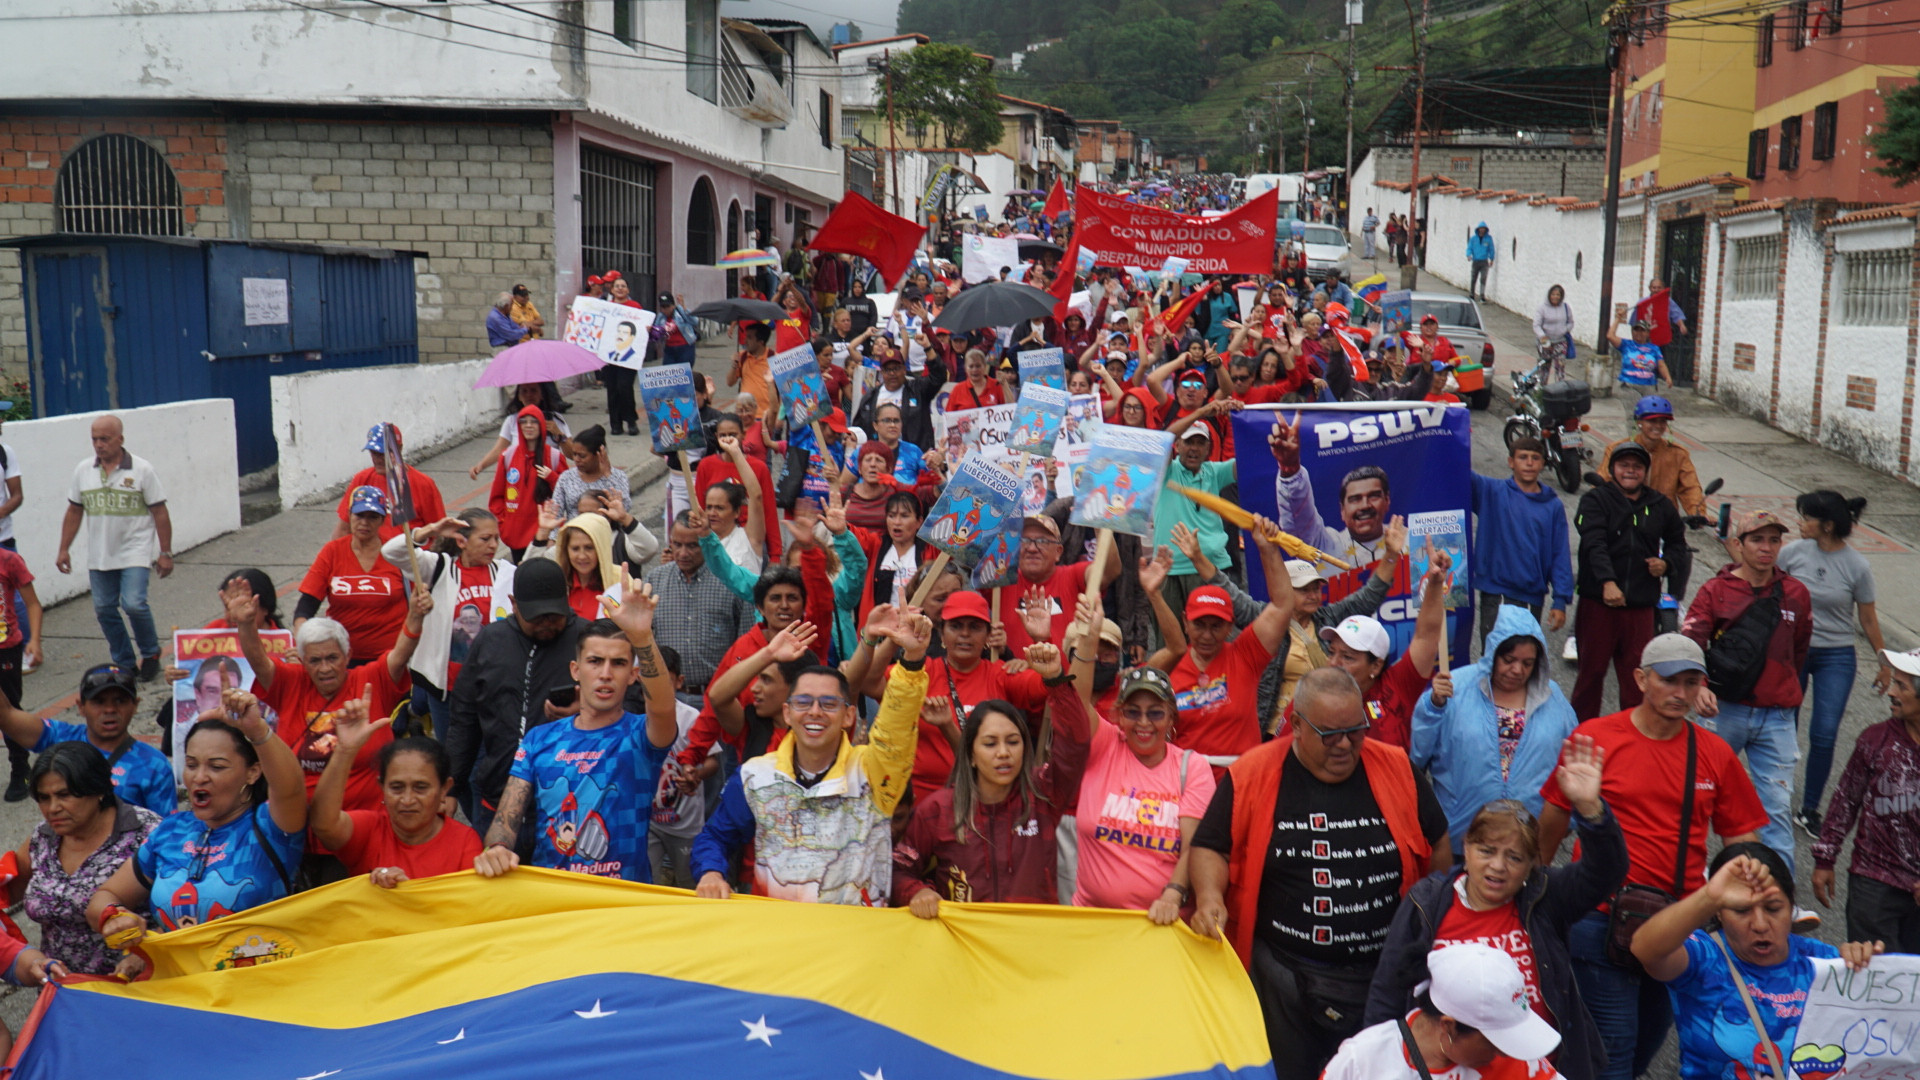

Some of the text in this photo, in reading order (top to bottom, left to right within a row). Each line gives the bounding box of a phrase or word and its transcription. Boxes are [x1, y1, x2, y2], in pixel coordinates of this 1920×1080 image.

[1111, 225, 1236, 242] CON MADURO,
[1135, 242, 1203, 256] MUNICIPIO
[1097, 251, 1228, 272] IBERTADO ERIDA
[645, 368, 685, 378] MUNICIPIO
[643, 376, 690, 388] LIBERTADOR
[985, 408, 1014, 424] Parr
[1317, 447, 1347, 458] PARTIDO
[1348, 441, 1384, 453] SOCIALISTA
[1384, 437, 1405, 447] UNIDO
[1415, 428, 1453, 439] VENEZUELA
[971, 457, 1018, 489] MUNICIPIO
[963, 464, 1015, 501] LIBERTADOR
[1415, 515, 1457, 526] MUNICIPIO
[1412, 525, 1461, 536] LIBERTADOR
[182, 636, 287, 655] VOTA OR
[1278, 821, 1295, 832] Que
[1296, 821, 1308, 830] las
[1359, 817, 1369, 827] de
[1371, 818, 1380, 826] tu
[1275, 848, 1282, 858] y
[1286, 847, 1295, 857] el
[1355, 848, 1367, 857] de
[1370, 845, 1384, 854] tus
[570, 861, 621, 875] Maduro
[1316, 871, 1399, 889] Oigan y sientan
[1303, 902, 1311, 913] la
[1318, 900, 1369, 915] Felicidad
[1373, 898, 1383, 908] de
[1272, 919, 1311, 941] mientras
[1823, 964, 1920, 1006] NUEST
